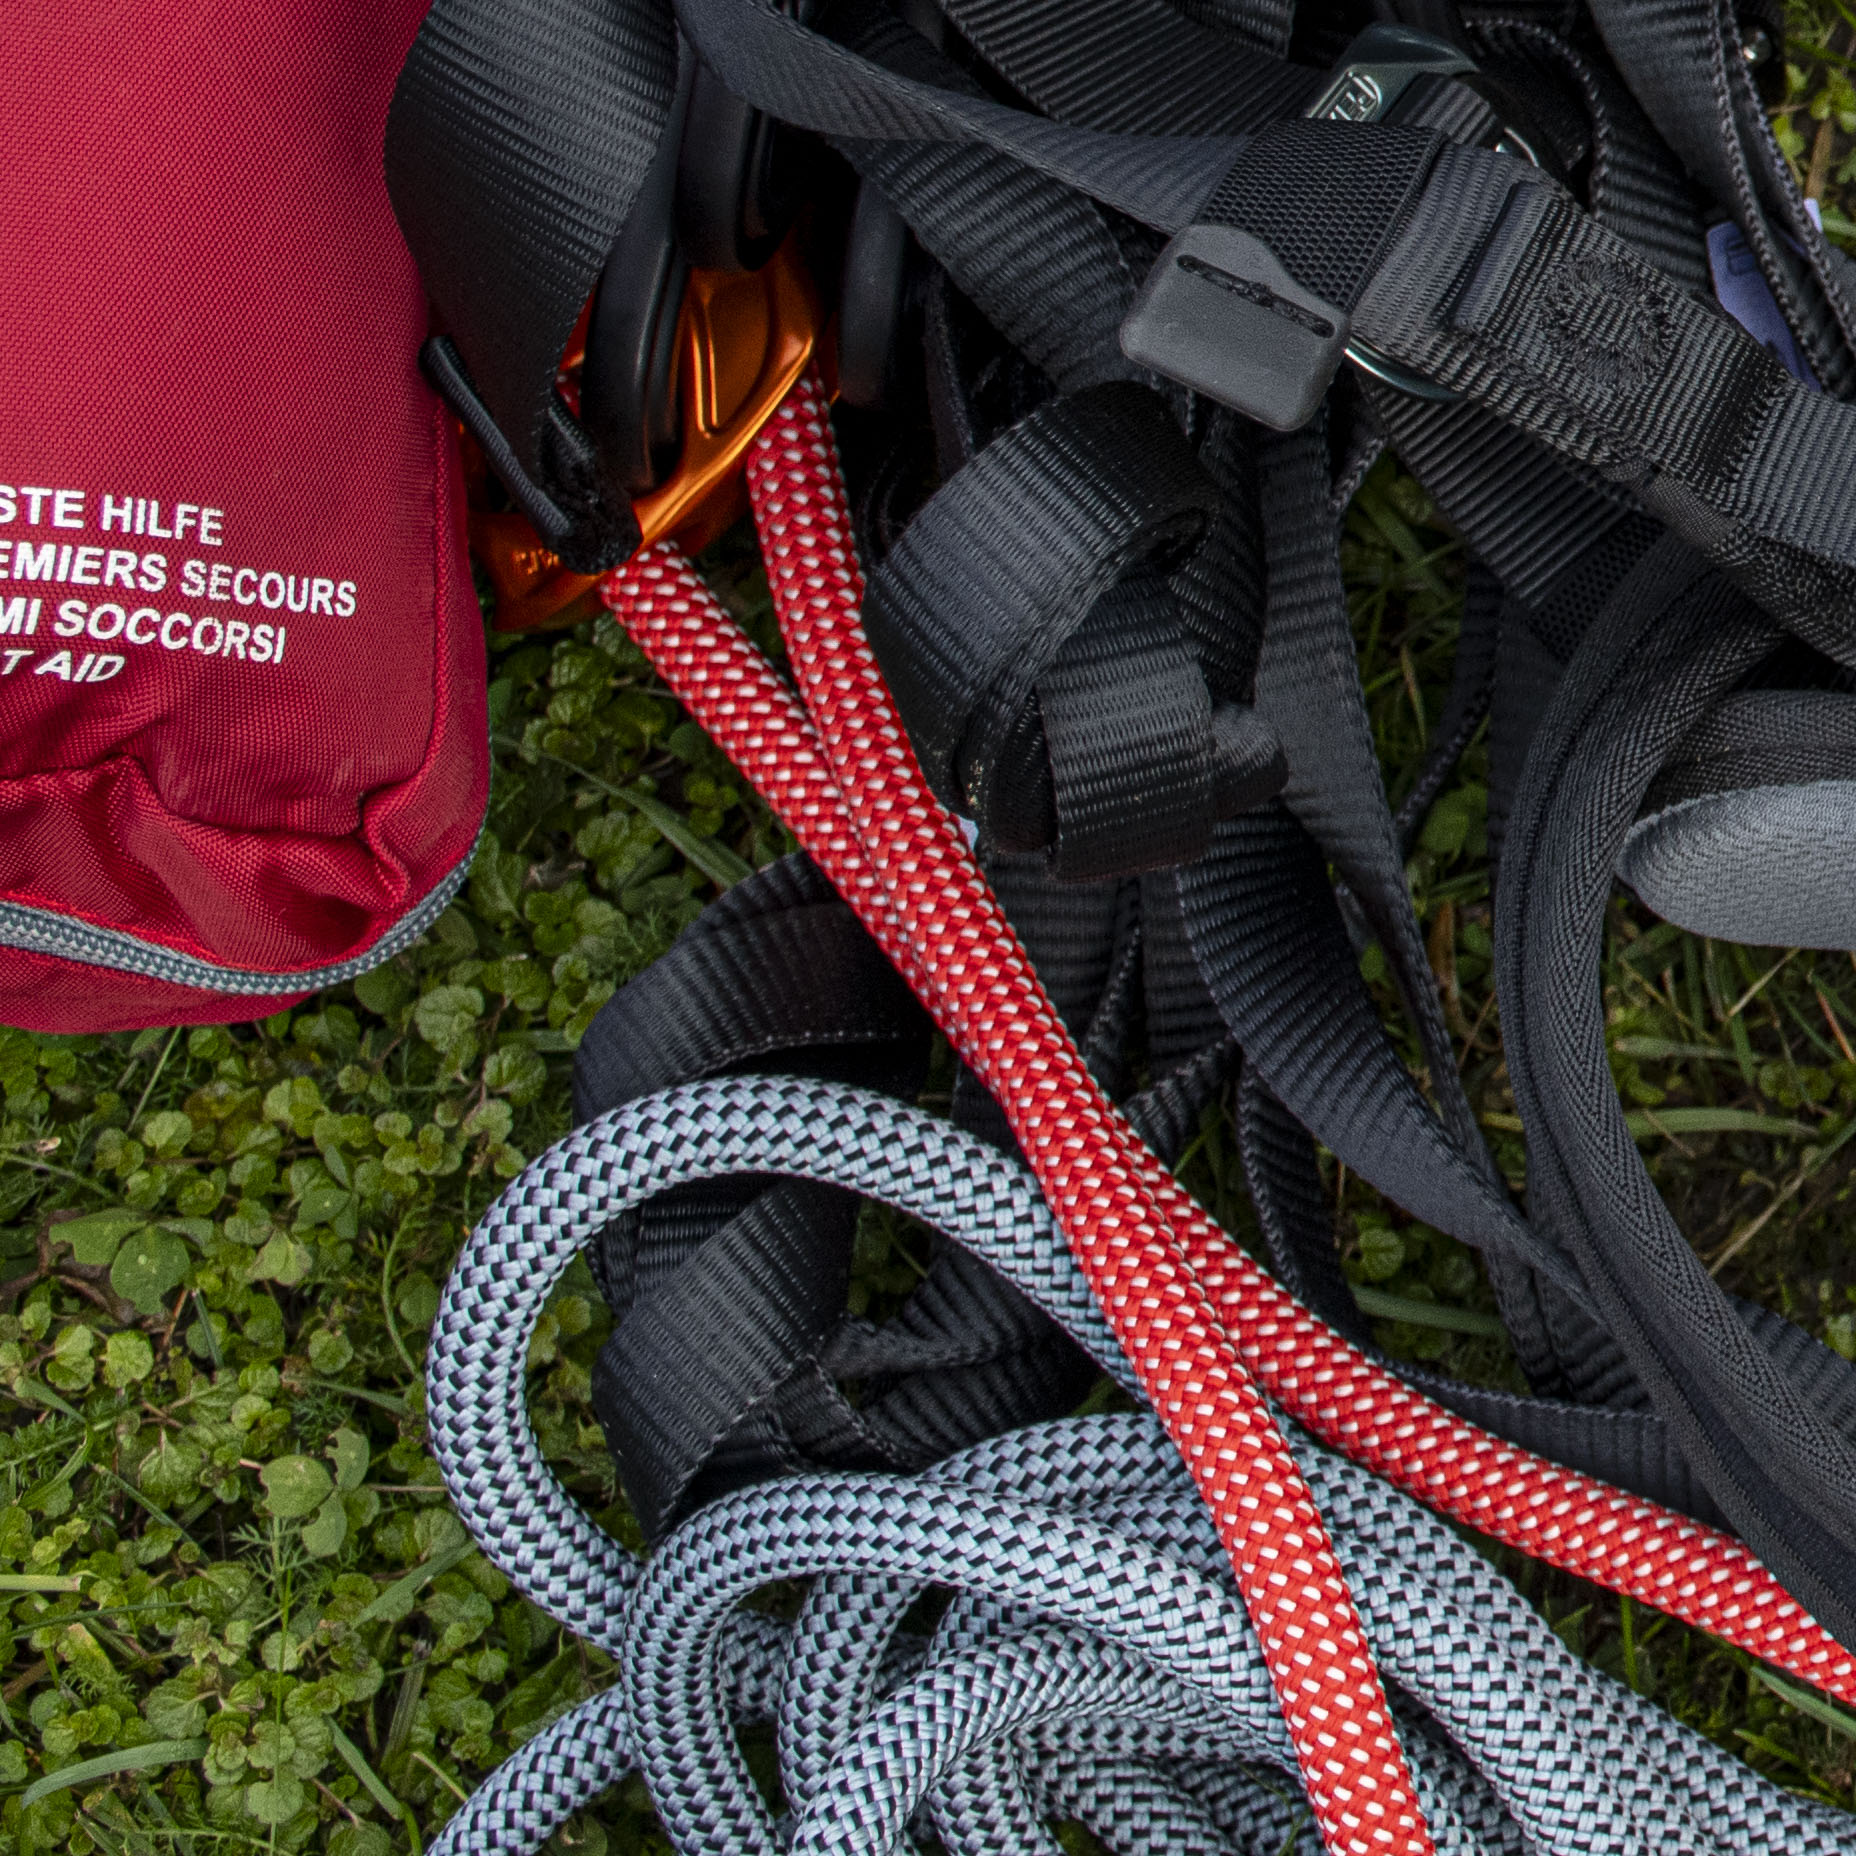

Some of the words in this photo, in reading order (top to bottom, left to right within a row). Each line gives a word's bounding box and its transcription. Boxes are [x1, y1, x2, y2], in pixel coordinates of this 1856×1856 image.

[102, 494, 223, 546] HILFE
[181, 560, 357, 617] SECOURS
[54, 600, 286, 663] SOCCORSI
[34, 650, 126, 682] AID
